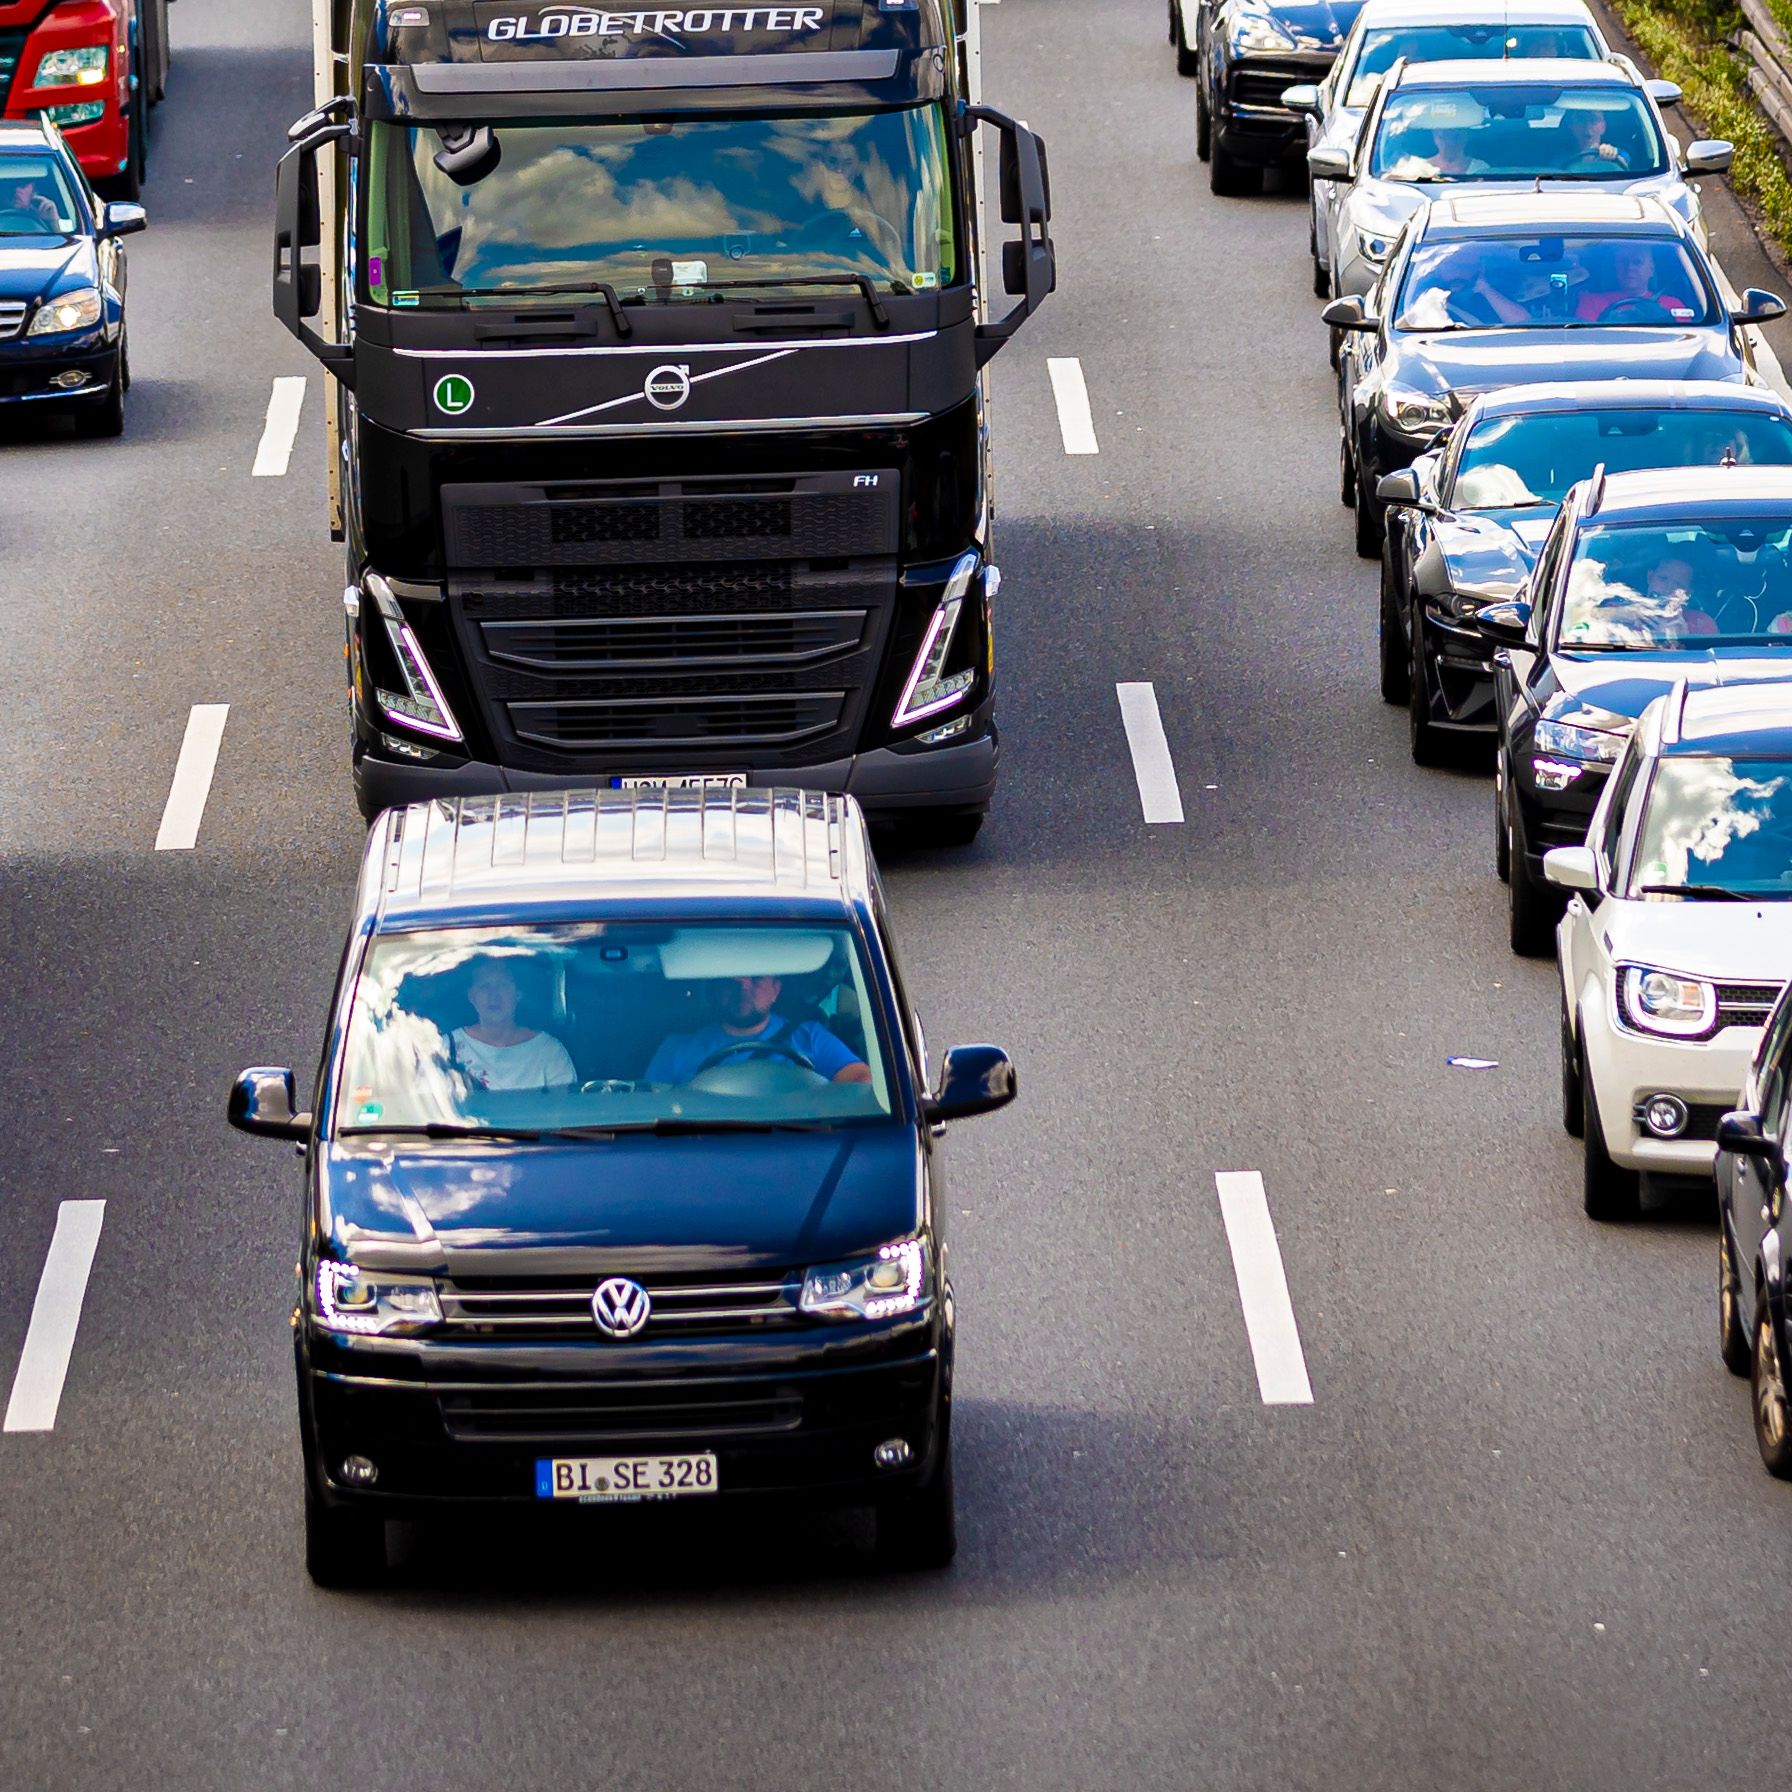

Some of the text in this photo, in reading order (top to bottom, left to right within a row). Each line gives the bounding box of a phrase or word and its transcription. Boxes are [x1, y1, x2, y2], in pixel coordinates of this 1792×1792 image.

[488, 7, 824, 41] GLOBETROTTER
[446, 382, 464, 407] L
[650, 384, 685, 392] VOLVO
[853, 474, 879, 488] FH
[555, 1459, 713, 1492] BI SE 328
